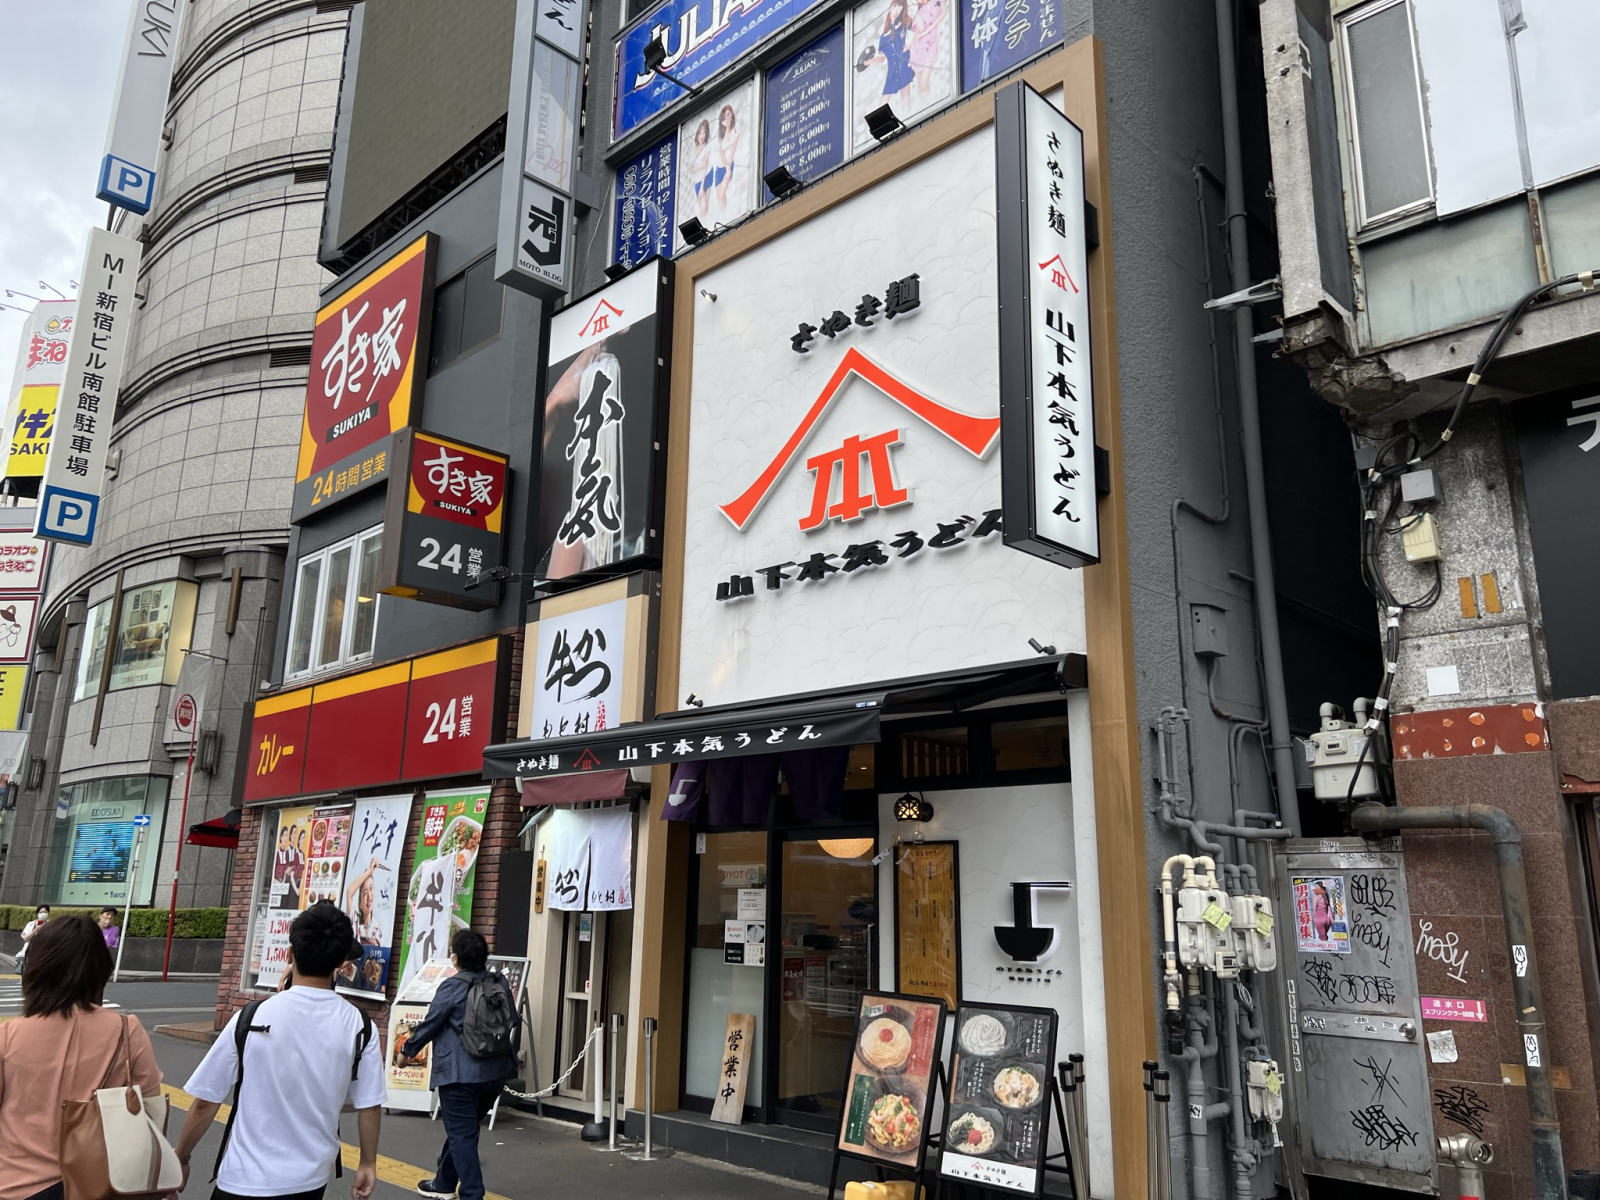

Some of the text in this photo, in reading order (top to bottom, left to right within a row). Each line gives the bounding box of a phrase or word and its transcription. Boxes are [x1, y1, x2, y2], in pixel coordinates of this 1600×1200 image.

[636, 154, 653, 265] リラクゼーション
[1046, 131, 1067, 239] さぬき麺
[519, 259, 562, 283] MOTO BLDG
[790, 272, 921, 353] さぬき麺
[321, 298, 407, 411] すき家
[332, 406, 372, 439] SUKIYA
[1044, 308, 1081, 524] 山下本気うどん
[423, 447, 495, 507] すき家
[439, 501, 472, 516] SUKIYA
[417, 537, 484, 580] 24 営業
[422, 695, 474, 744] 24 営業
[256, 734, 295, 776] カレー
[516, 754, 560, 772] さぬき麺
[618, 724, 822, 762] 山下本気うどん
[1296, 884, 1313, 939] 男性募集
[1432, 999, 1465, 1009] 送水口
[721, 1030, 743, 1105] 営業中
[951, 1169, 1024, 1189] 山下本気うどん
